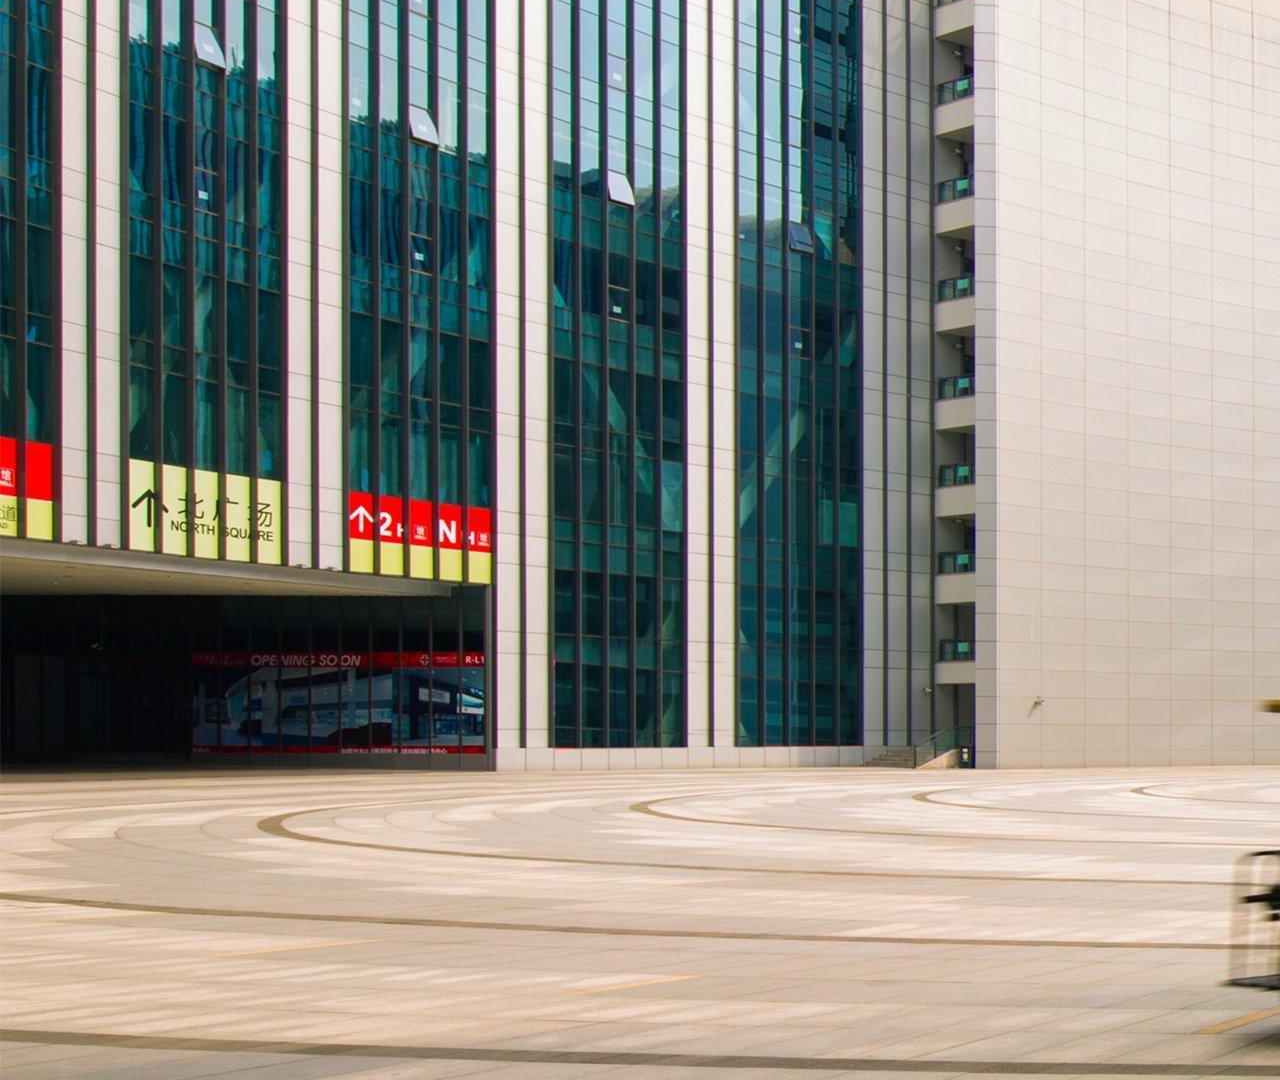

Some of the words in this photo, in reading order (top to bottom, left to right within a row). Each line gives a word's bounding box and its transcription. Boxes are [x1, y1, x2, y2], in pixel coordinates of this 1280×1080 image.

[170, 520, 215, 536] NORTH
[250, 655, 316, 667] OPENING
[319, 655, 361, 667] SOON
